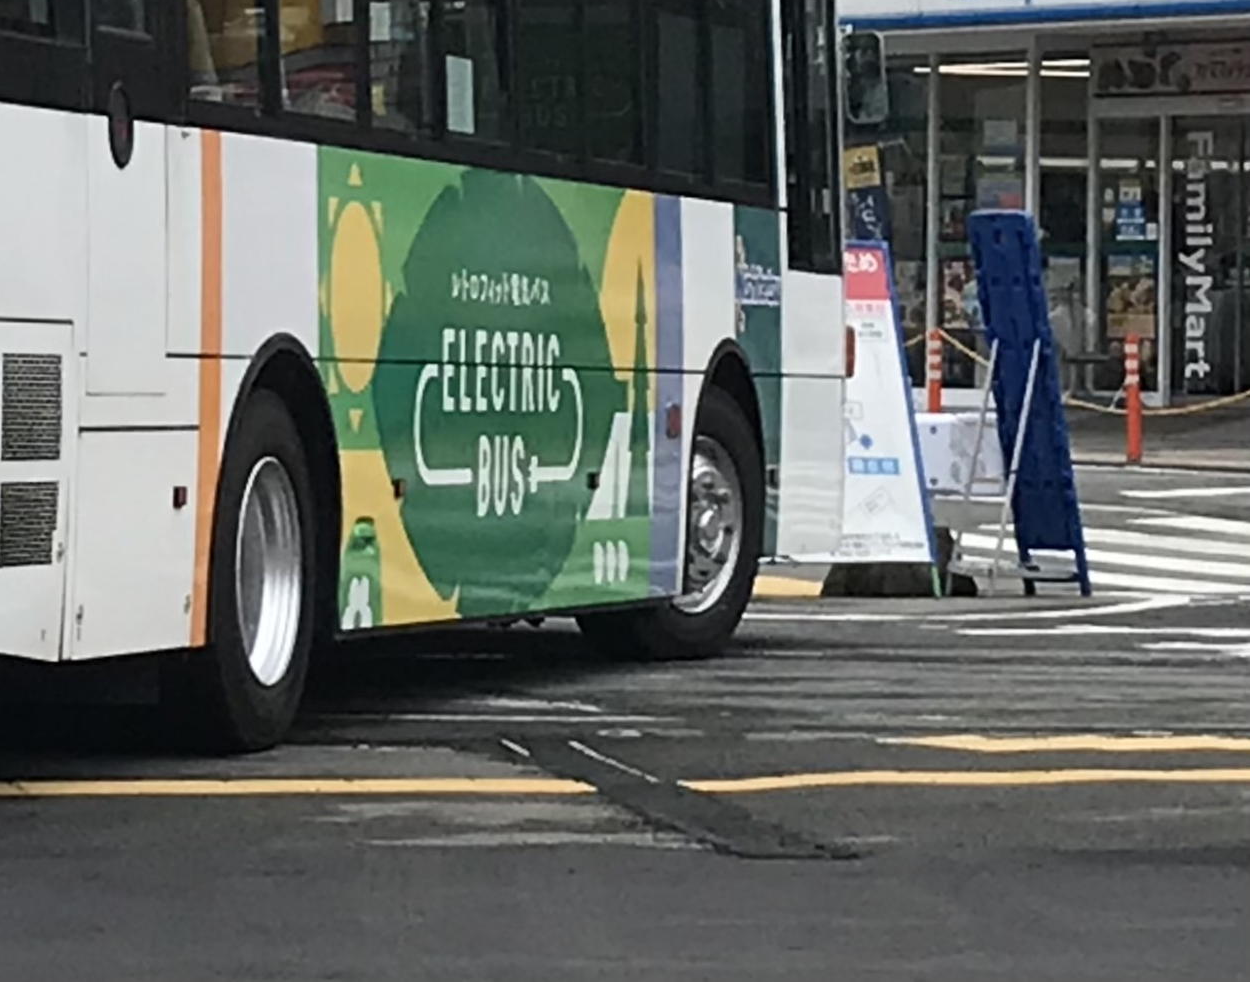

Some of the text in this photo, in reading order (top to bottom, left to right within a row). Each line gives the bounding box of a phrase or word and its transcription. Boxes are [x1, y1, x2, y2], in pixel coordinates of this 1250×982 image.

[1177, 130, 1215, 380] FamilyMart
[441, 328, 561, 412] ELECTRIC
[476, 434, 526, 518] BUS
